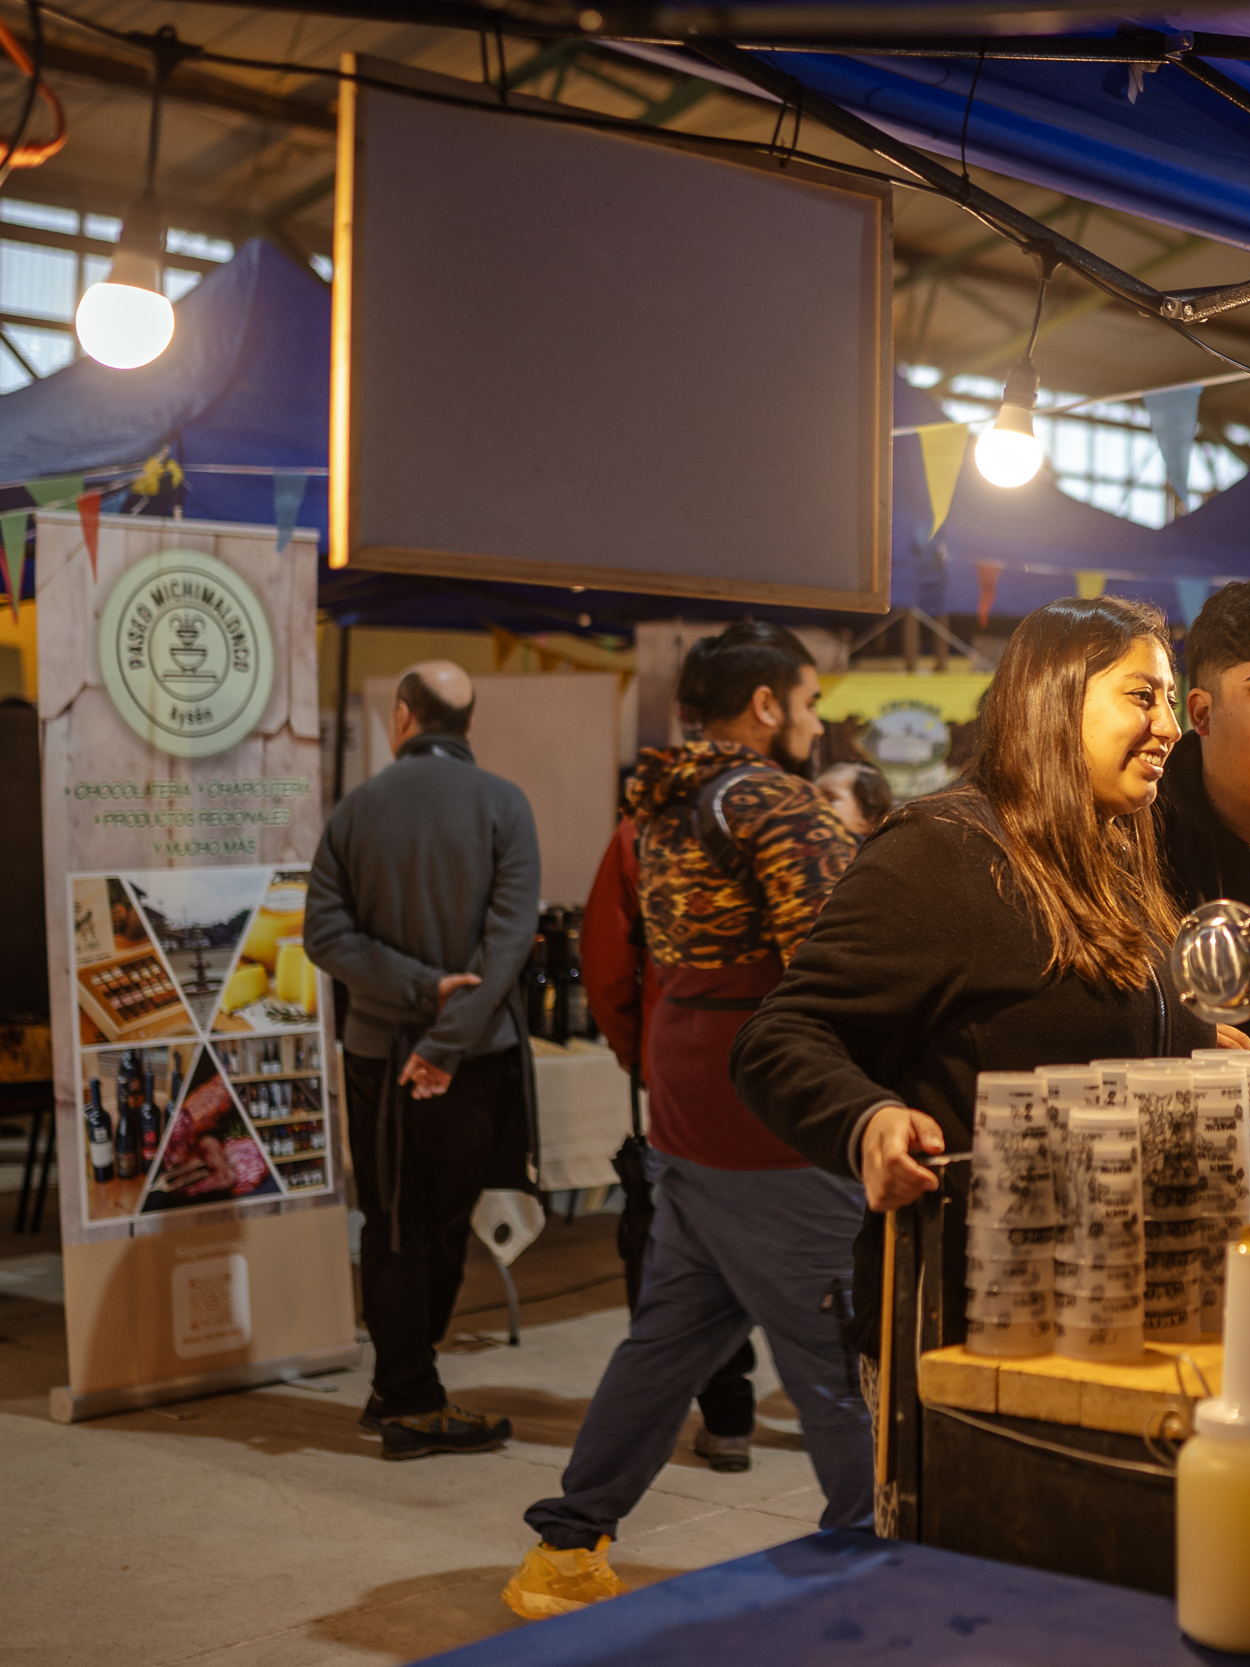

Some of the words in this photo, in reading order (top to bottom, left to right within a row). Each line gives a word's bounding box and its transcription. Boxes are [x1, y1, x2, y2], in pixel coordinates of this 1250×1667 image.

[128, 603, 152, 670] PASEO
[103, 809, 195, 829] PRODUCTOS
[198, 807, 291, 827] REGIONALES
[165, 840, 220, 857] MUCHO
